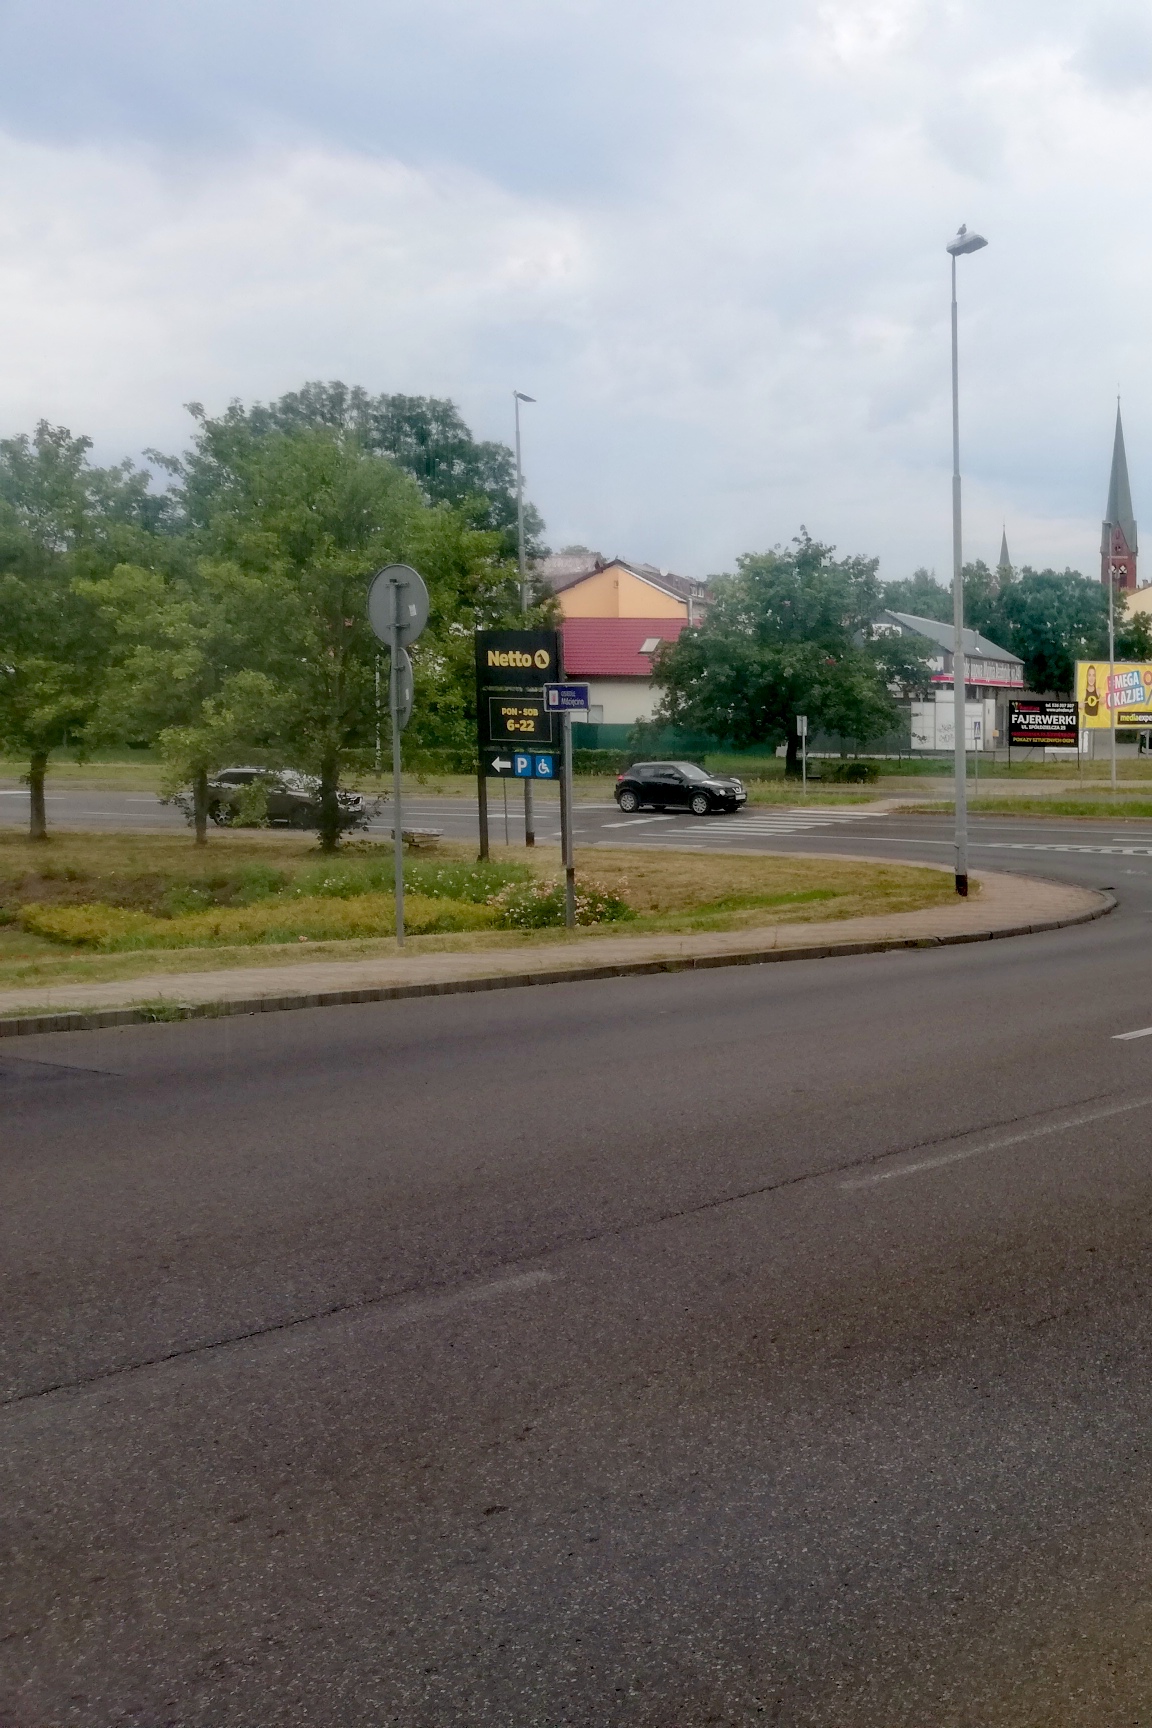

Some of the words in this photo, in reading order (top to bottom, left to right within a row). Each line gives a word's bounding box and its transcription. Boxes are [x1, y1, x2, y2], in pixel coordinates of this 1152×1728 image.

[487, 650, 532, 667] Netto
[1114, 671, 1140, 689] MEGA
[501, 707, 517, 716] PON
[523, 708, 539, 717] SOB
[506, 719, 535, 732] 6-22
[1011, 714, 1077, 725] FAJERWERKI
